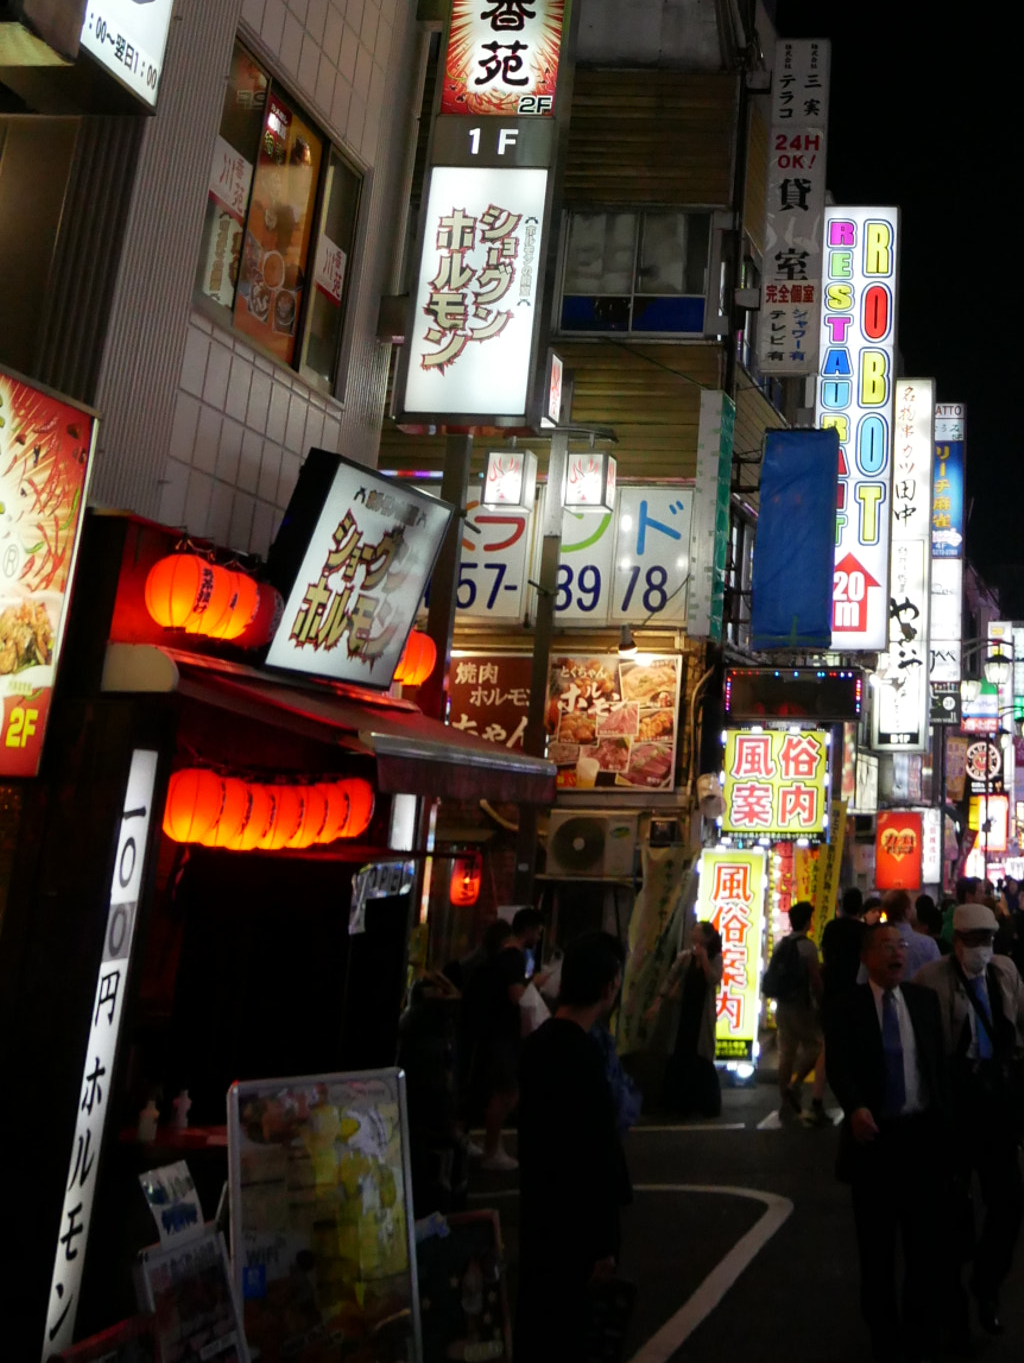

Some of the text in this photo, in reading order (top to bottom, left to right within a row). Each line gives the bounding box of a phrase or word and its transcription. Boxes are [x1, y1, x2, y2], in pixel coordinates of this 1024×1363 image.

[517, 94, 553, 114] 2F
[778, 74, 797, 120] テラコ
[774, 134, 821, 152] 24H
[777, 154, 817, 170] OK!
[418, 205, 479, 376] ホルモン
[765, 284, 815, 304] 完全個室
[858, 218, 893, 546] ROBOT
[832, 570, 866, 602] 20
[835, 600, 860, 628] m
[454, 662, 500, 687] 焼肉
[6, 707, 39, 749] 2F
[731, 732, 822, 780] 風俗
[730, 780, 818, 826] 案内
